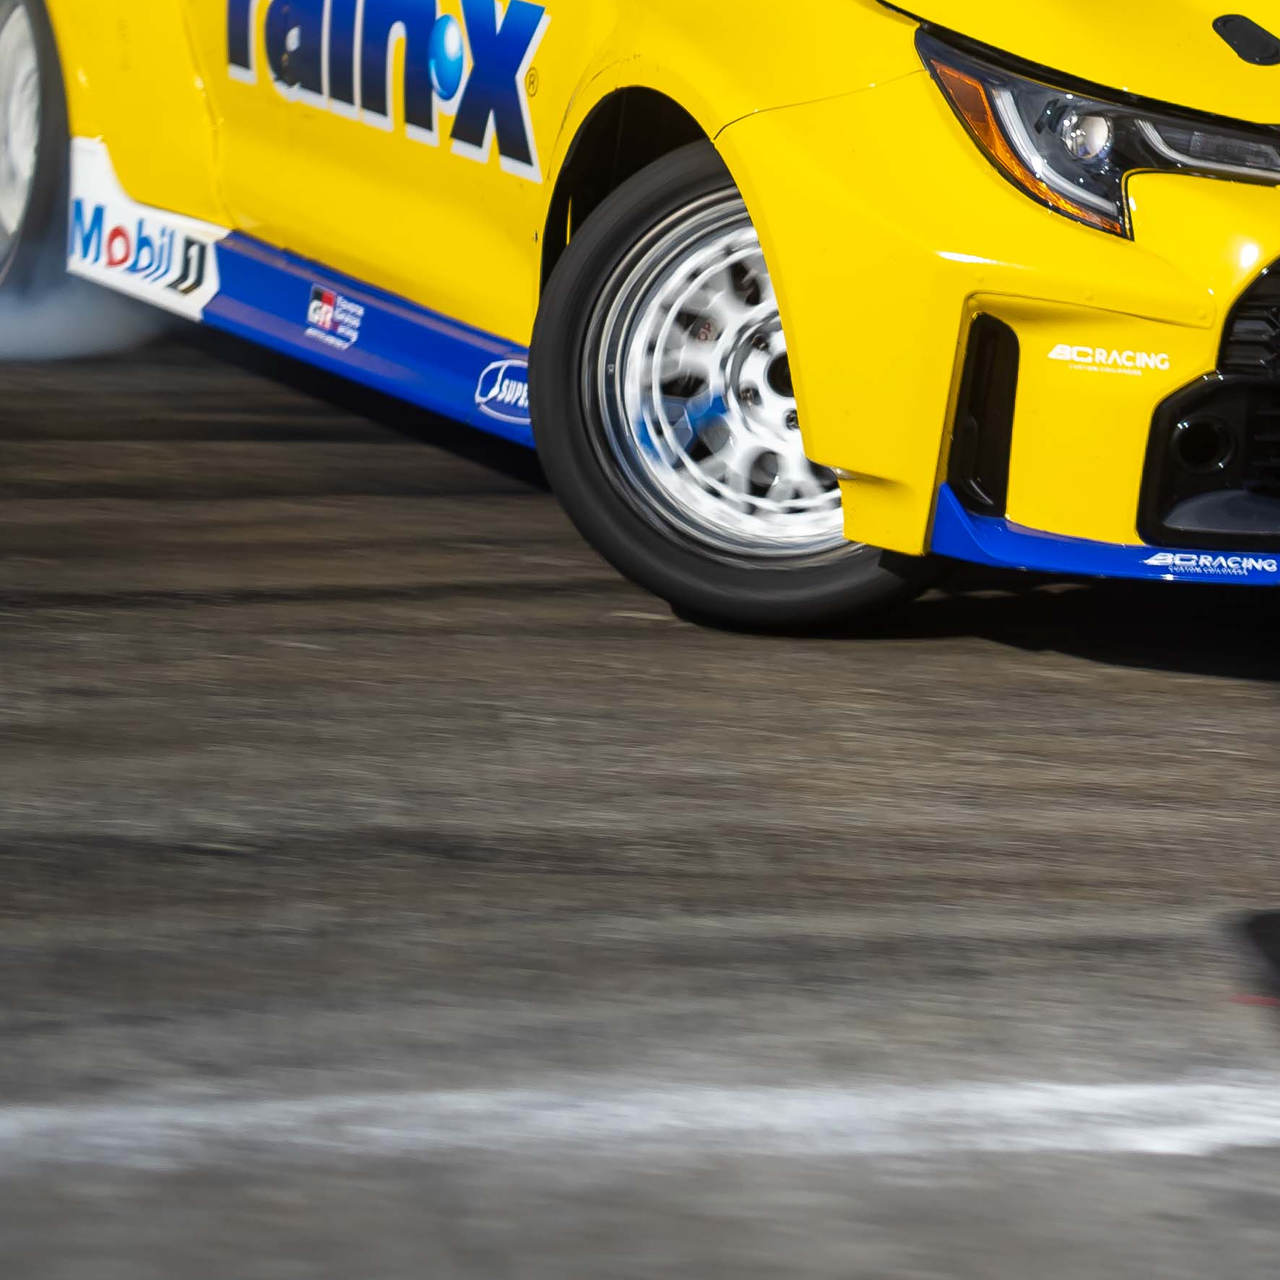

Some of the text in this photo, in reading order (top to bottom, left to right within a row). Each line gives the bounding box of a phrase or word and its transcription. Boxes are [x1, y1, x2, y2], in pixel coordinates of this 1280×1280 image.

[68, 197, 176, 283] Mobil
[1047, 343, 1093, 363] BC
[1094, 347, 1171, 371] RACING
[1198, 554, 1279, 573] RACING
